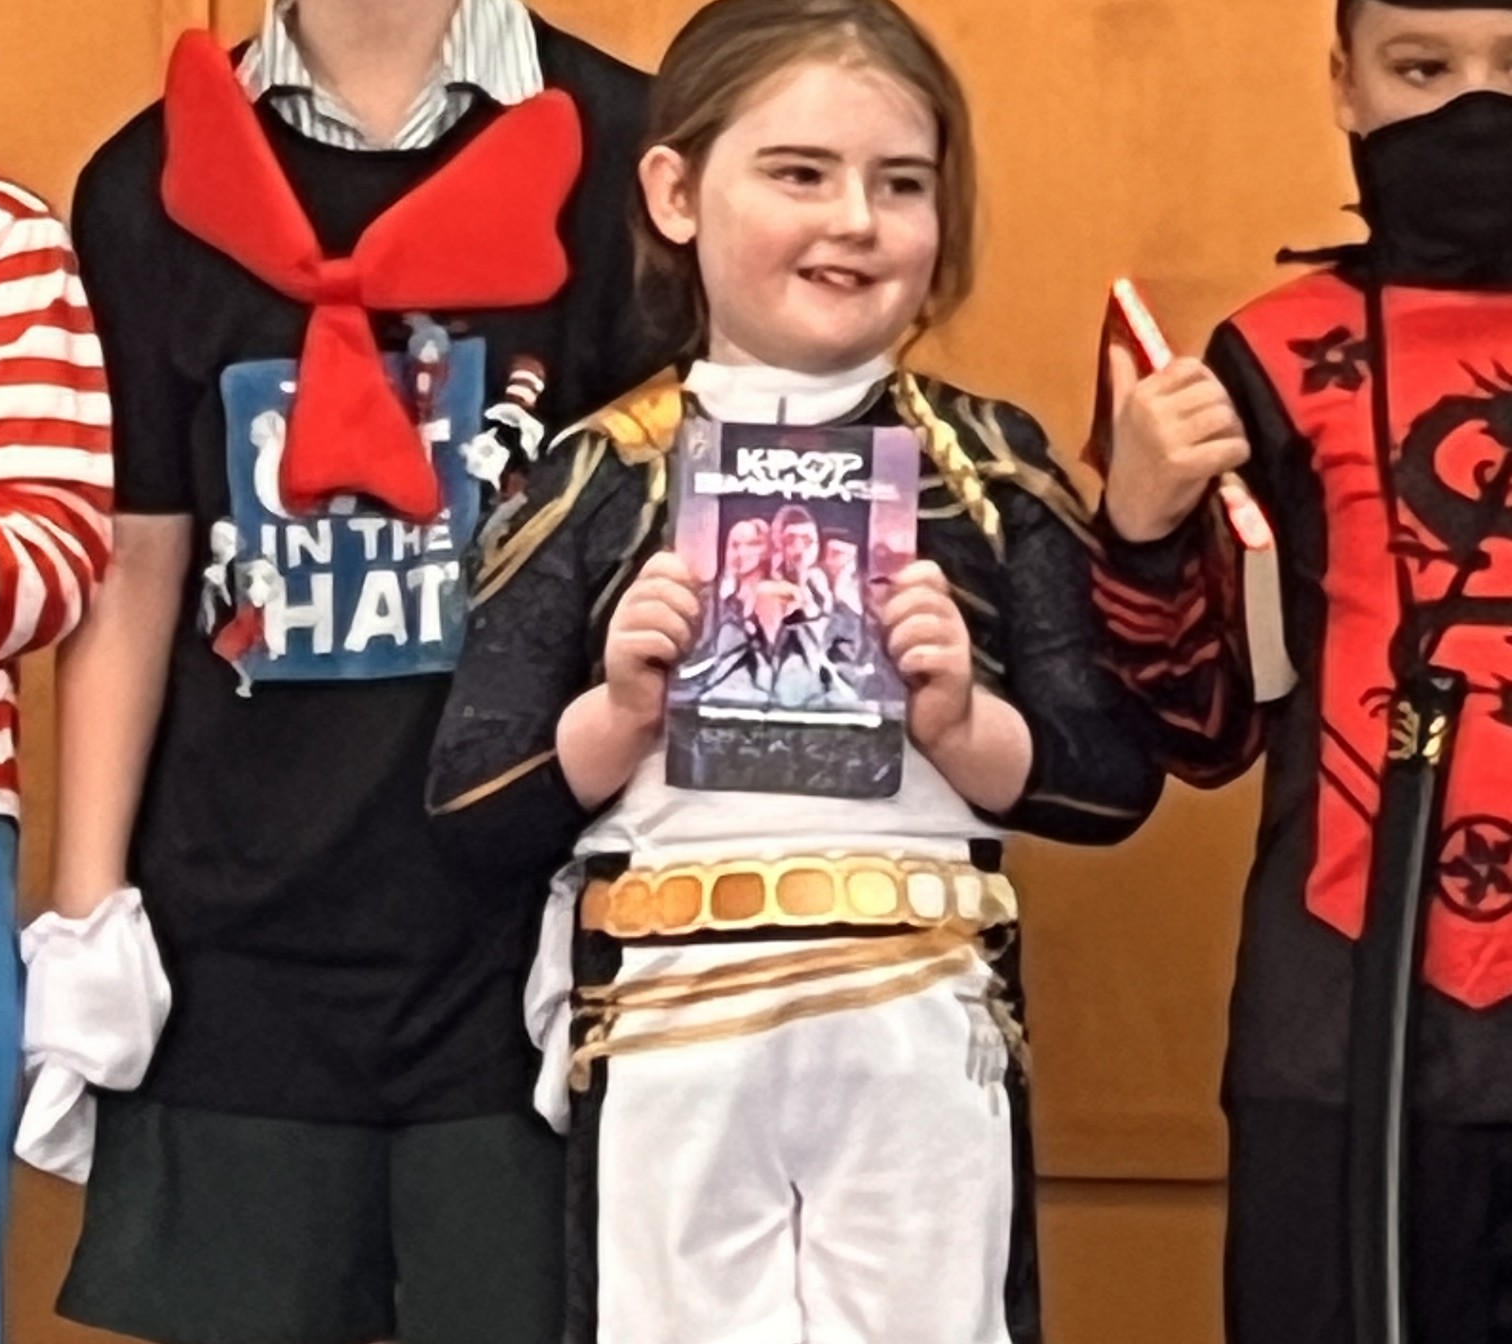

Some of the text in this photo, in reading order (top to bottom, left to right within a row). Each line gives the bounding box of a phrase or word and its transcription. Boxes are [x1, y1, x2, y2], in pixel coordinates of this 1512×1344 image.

[260, 517, 454, 568] IN THE
[263, 560, 460, 661] HAT
